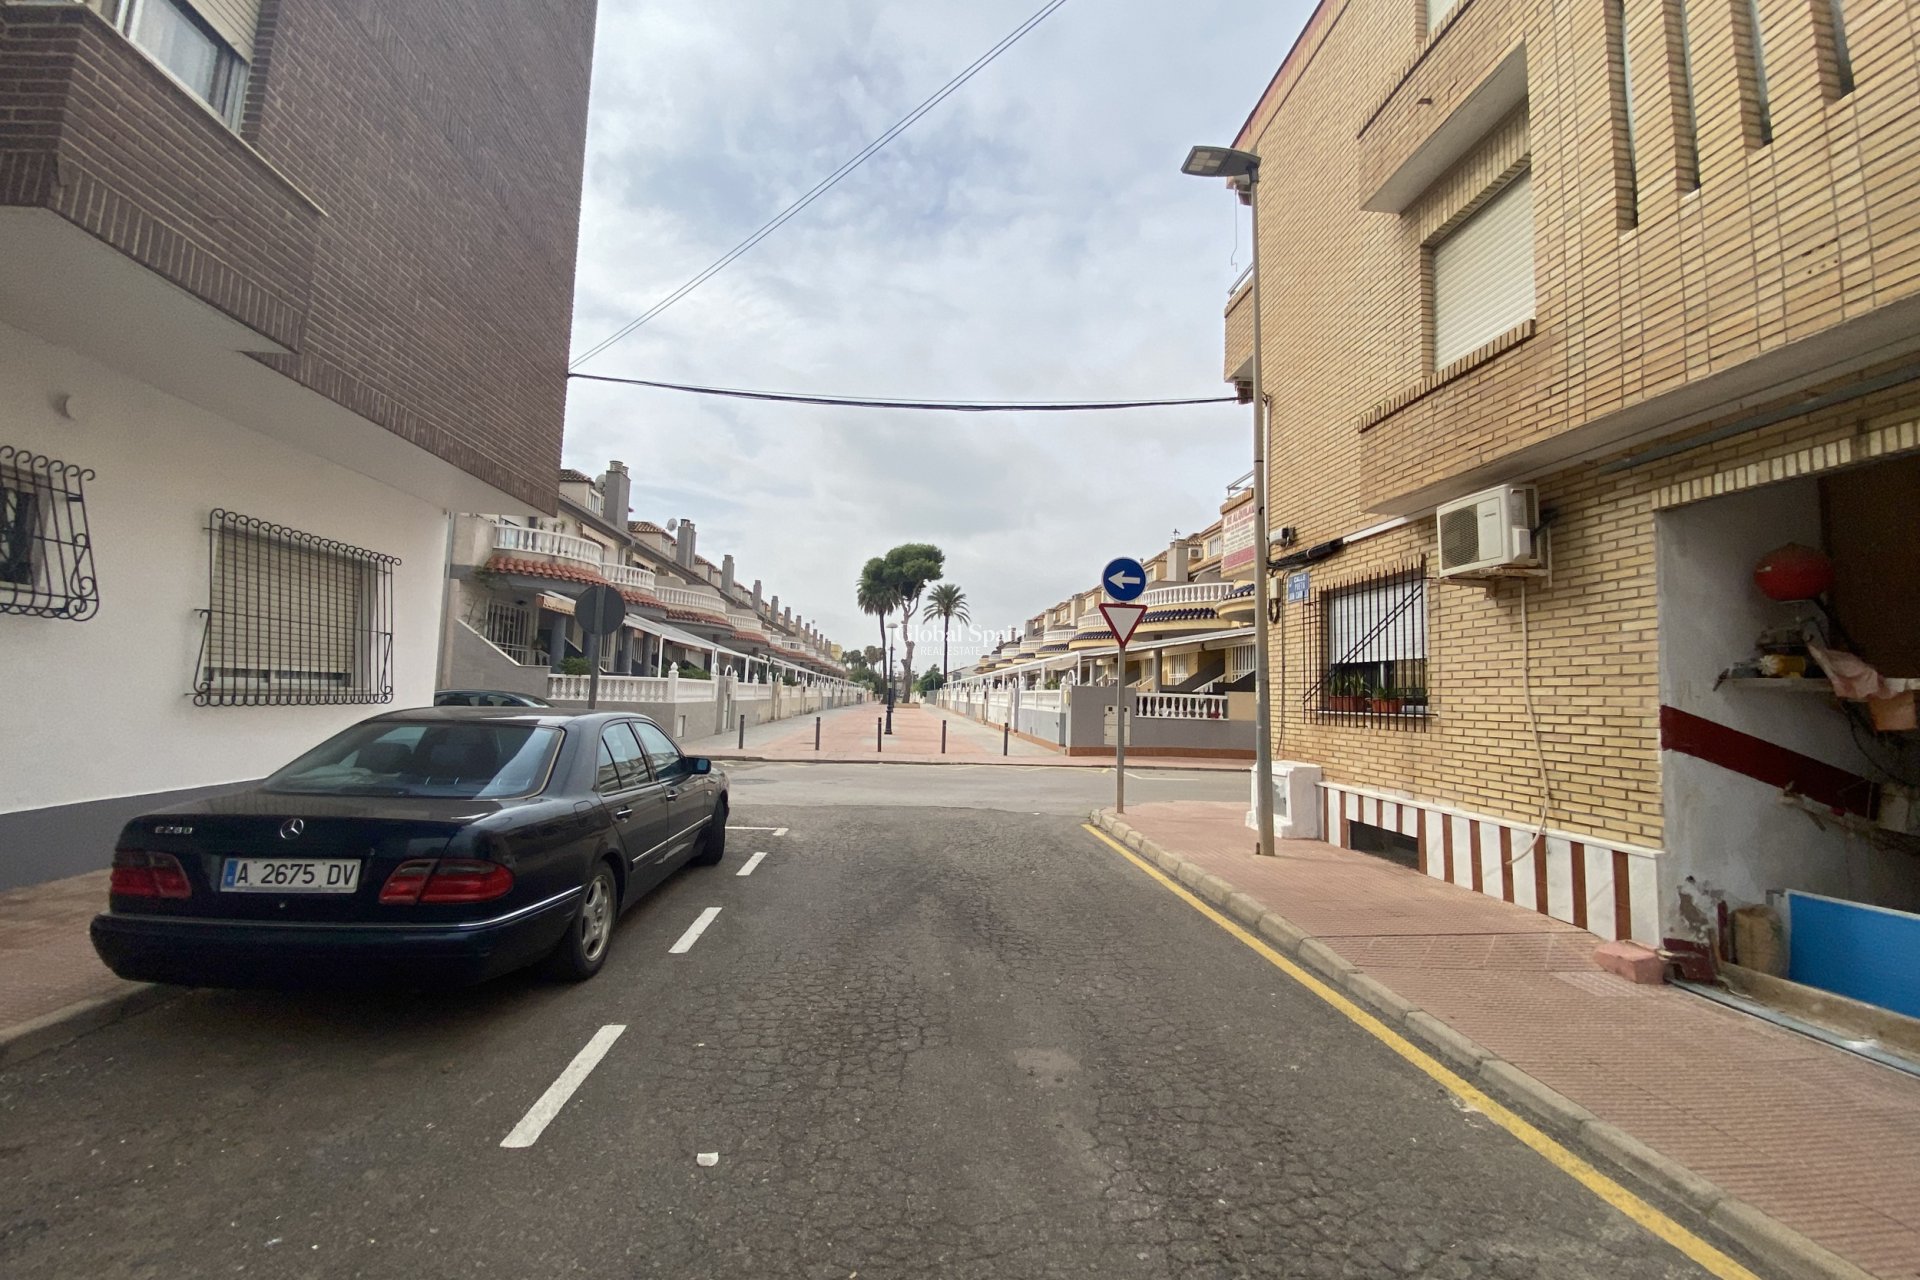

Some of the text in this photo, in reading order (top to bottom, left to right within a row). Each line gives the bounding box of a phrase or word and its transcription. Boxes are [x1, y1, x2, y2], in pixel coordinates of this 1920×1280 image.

[1293, 574, 1306, 583] CALLE
[236, 862, 356, 886] A 2675 DV
